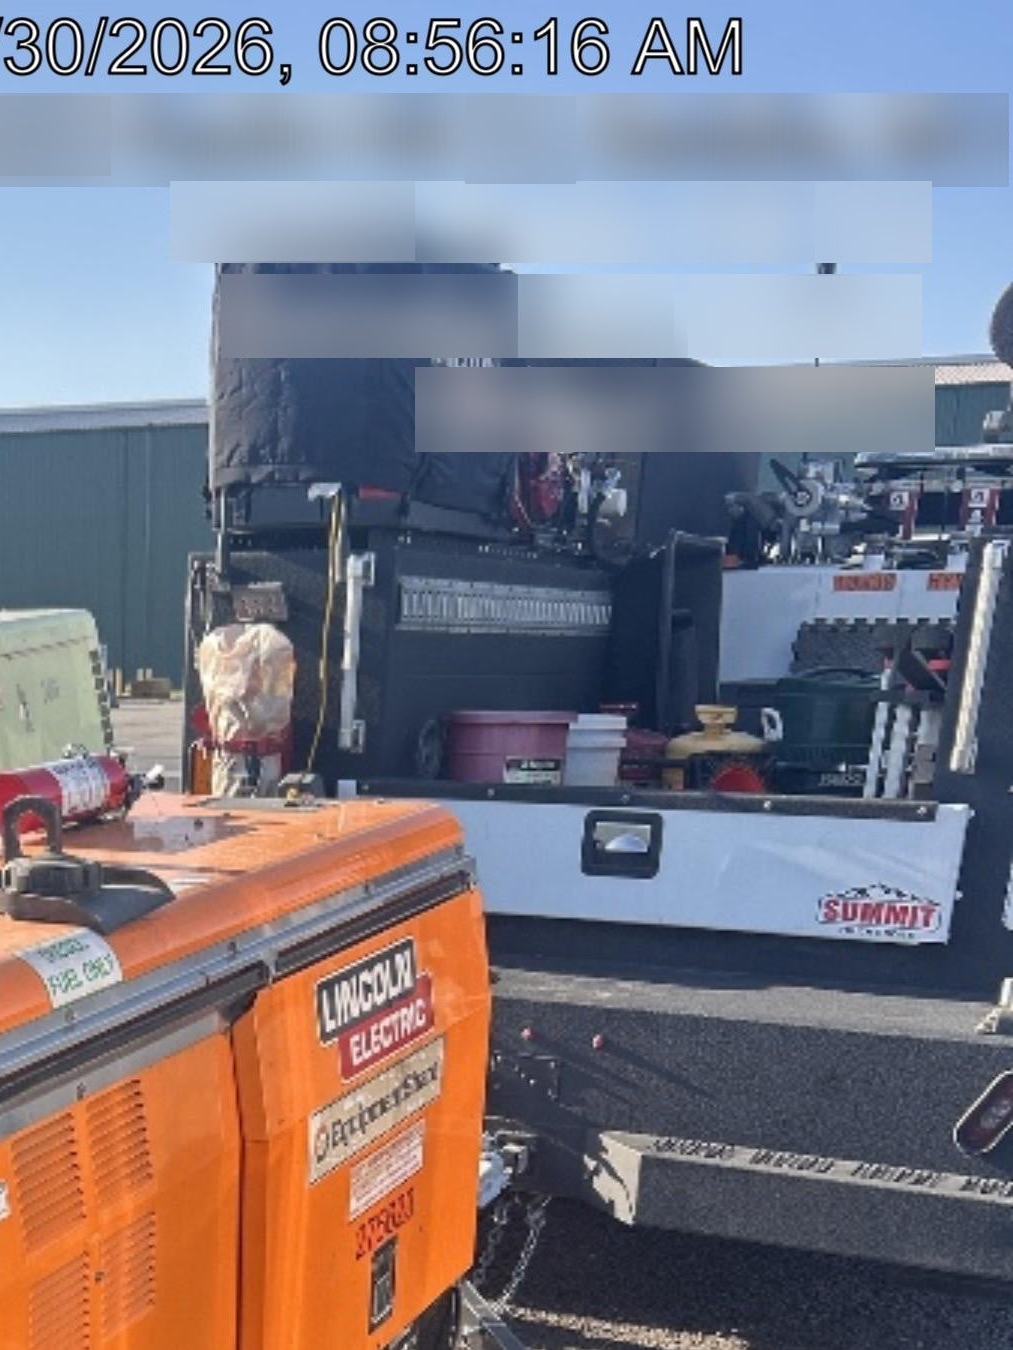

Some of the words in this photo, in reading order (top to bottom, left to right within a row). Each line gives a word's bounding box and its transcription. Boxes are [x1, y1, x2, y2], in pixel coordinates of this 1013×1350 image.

[823, 898, 937, 930] SUMMIT
[321, 947, 414, 1033] LINCOLN
[349, 997, 427, 1067] ELECTRIC
